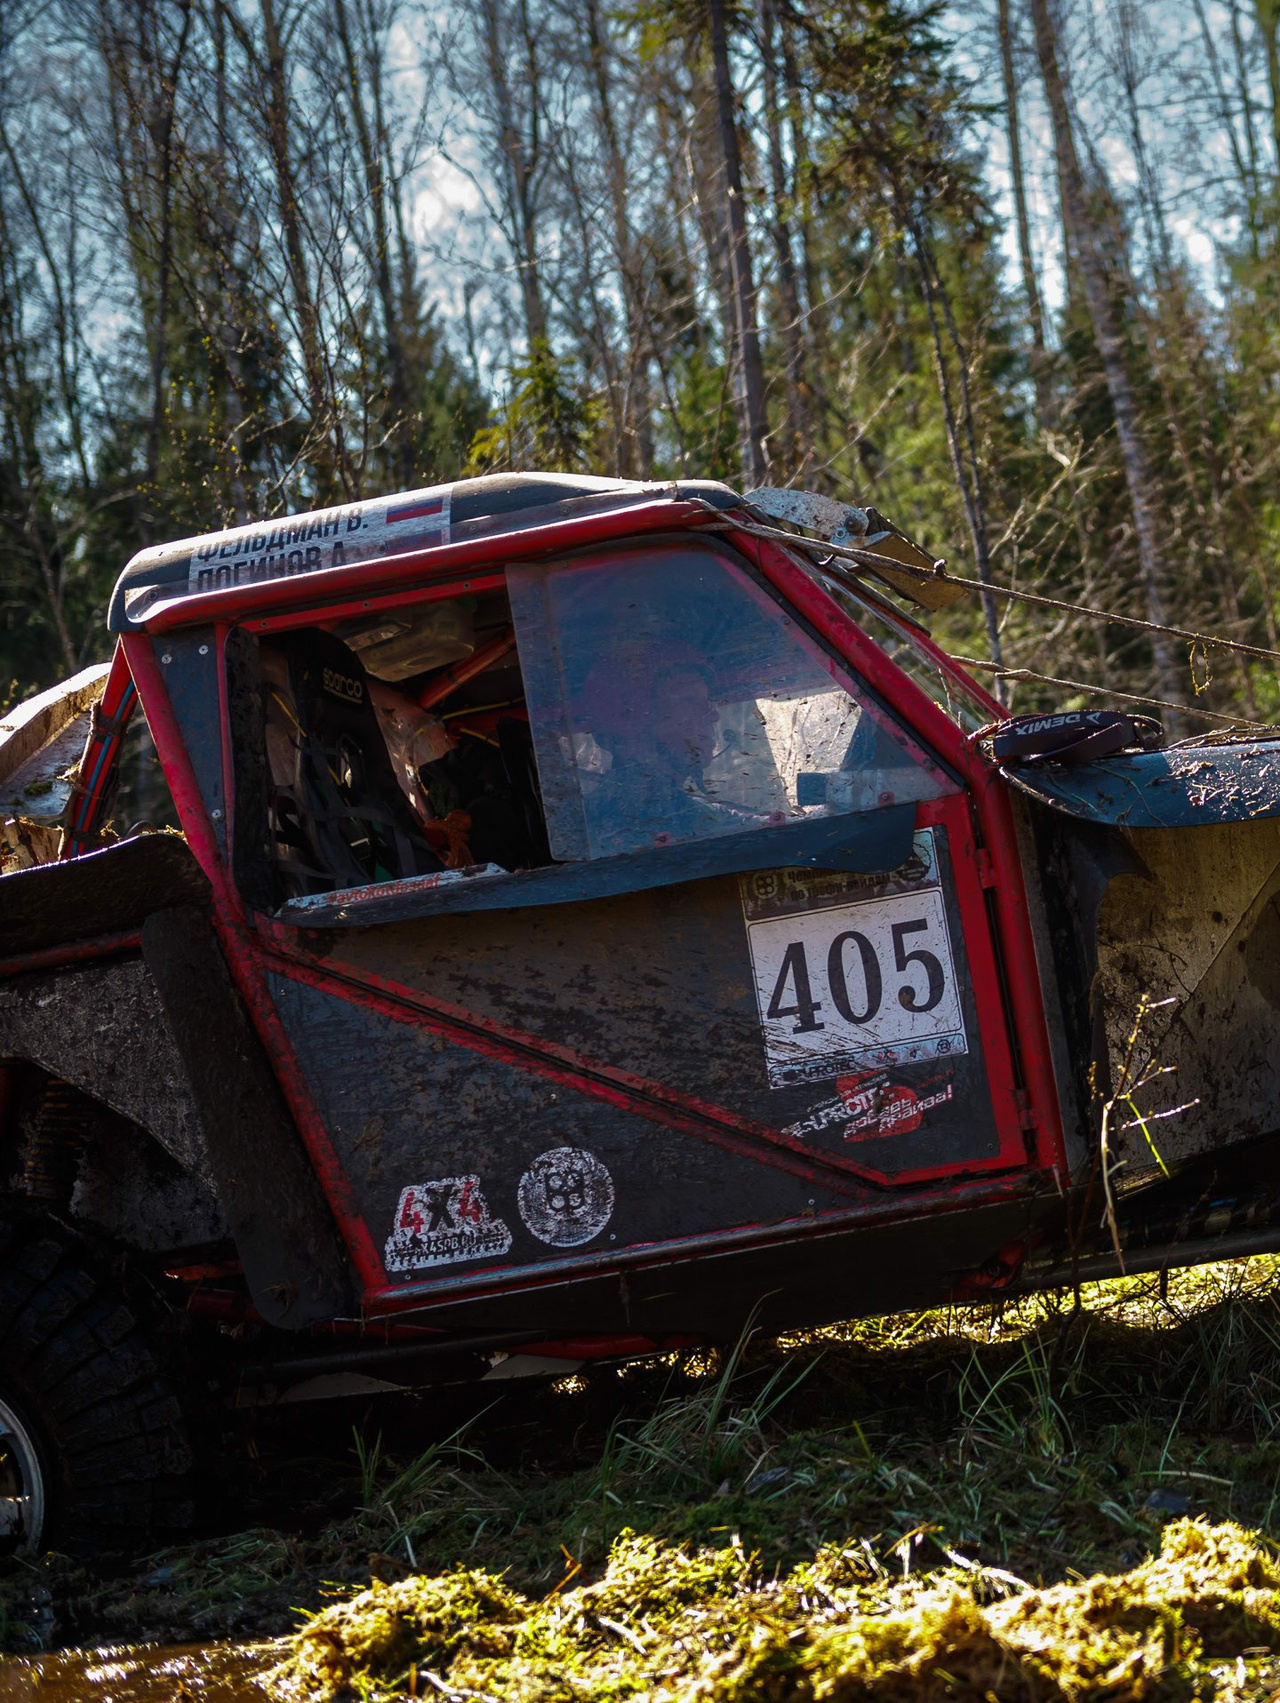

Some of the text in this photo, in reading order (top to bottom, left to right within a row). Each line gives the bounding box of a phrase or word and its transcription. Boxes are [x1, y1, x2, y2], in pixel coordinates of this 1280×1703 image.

[197, 509, 341, 562] ФЕЛЬДМАН
[1014, 713, 1081, 735] DEMIX
[767, 918, 945, 1034] 405
